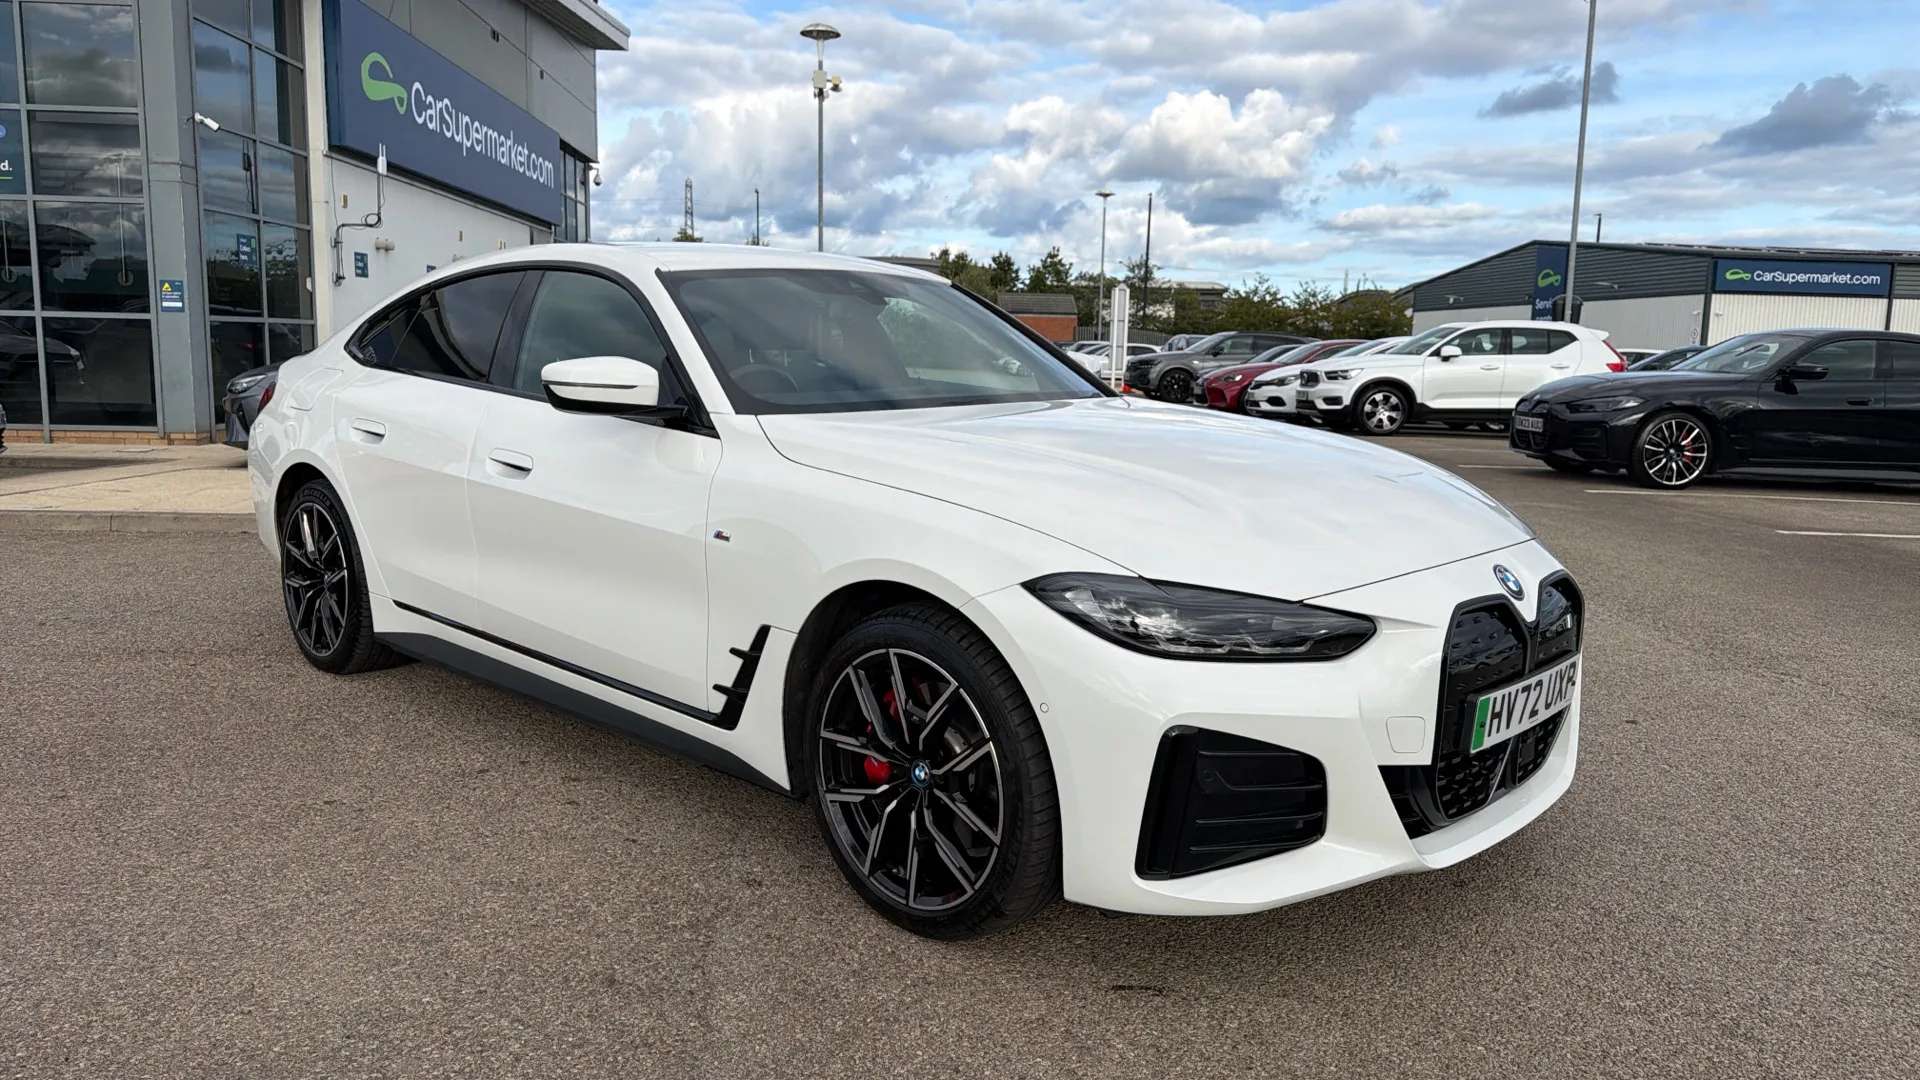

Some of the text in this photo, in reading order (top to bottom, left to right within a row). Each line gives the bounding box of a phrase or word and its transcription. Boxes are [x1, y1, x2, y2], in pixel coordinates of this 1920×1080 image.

[411, 82, 554, 188] CarSupermarket.com
[0, 159, 13, 171] d.
[1754, 270, 1880, 285] CarSupermarket.com
[1535, 298, 1552, 310] Servi
[1487, 679, 1543, 737] HV72
